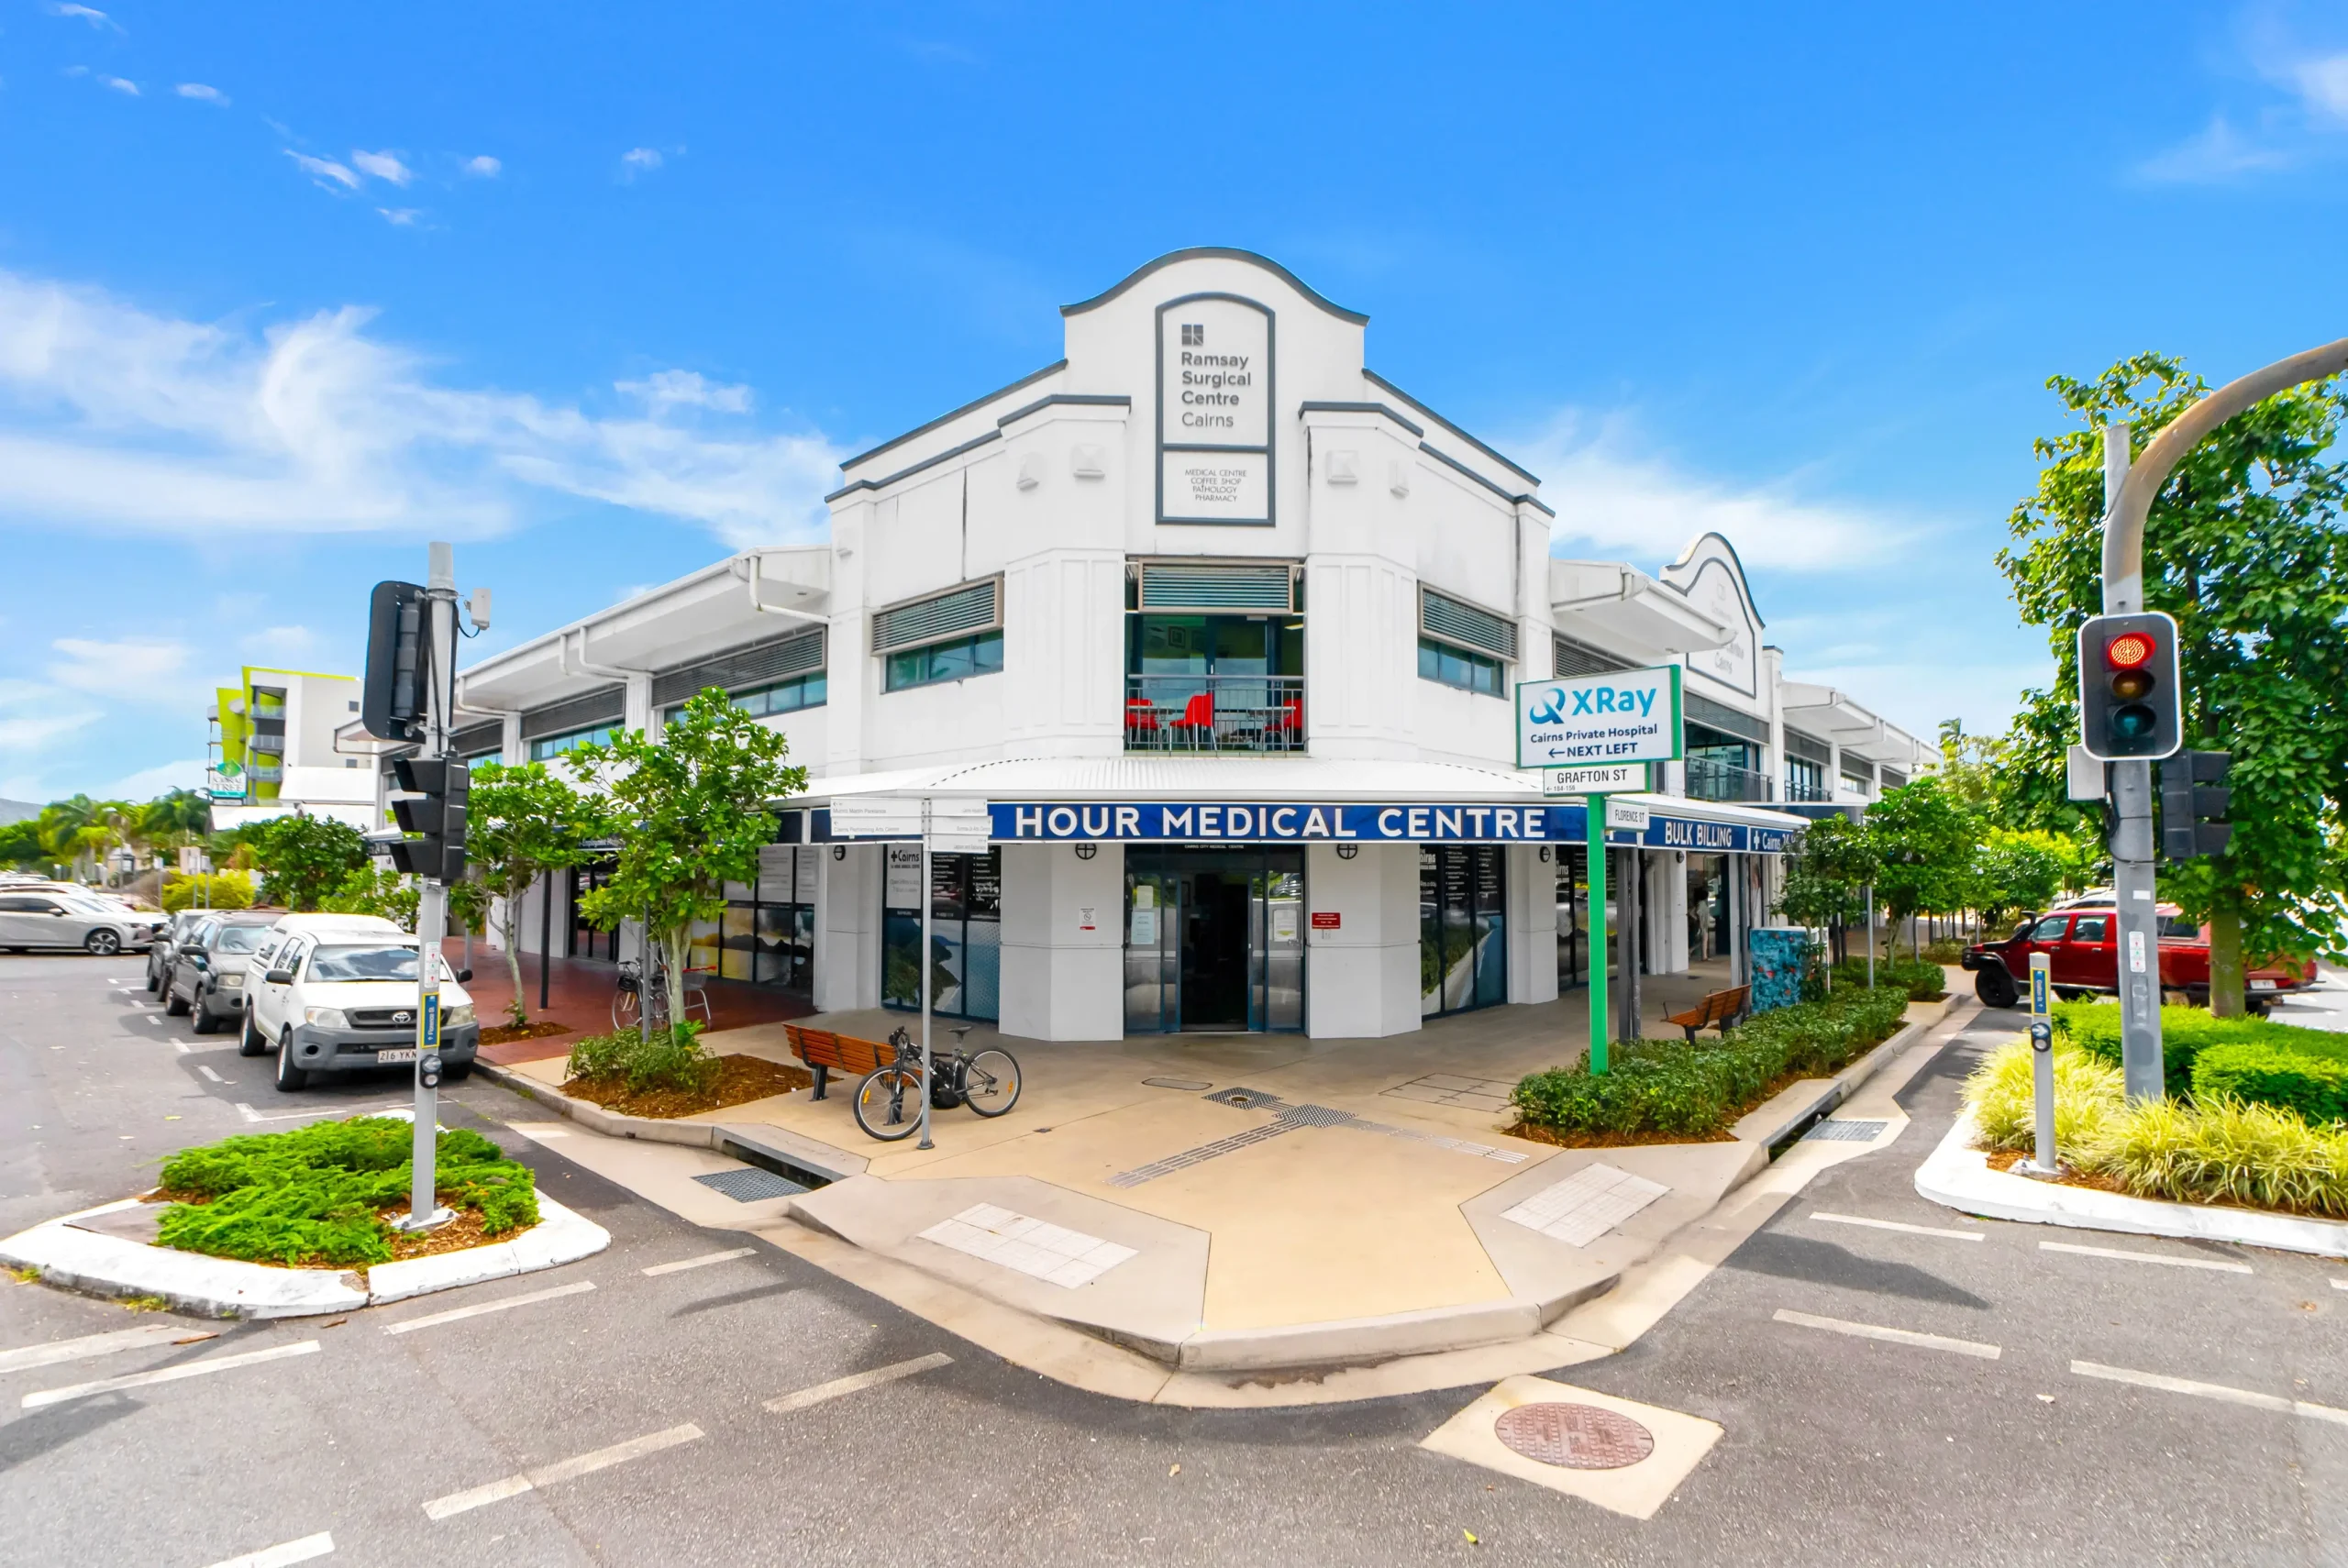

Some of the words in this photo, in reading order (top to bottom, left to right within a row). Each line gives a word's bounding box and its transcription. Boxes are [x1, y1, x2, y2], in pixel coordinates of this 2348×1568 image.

[1181, 351, 1249, 370] Ramsay
[1181, 370, 1251, 389] Surgical
[1181, 391, 1239, 405] Centre
[1181, 412, 1234, 427] Cairns
[1185, 469, 1216, 477] MEDICAL
[1220, 469, 1247, 477] CENTRE
[1191, 477, 1217, 485] COFFEE
[1221, 477, 1242, 485] SHOP
[1192, 485, 1237, 493] PATHOLOGY
[1195, 494, 1237, 502] PHARMACY
[1531, 733, 1564, 744] Cairns
[1566, 729, 1606, 742] Private
[1608, 723, 1658, 738] Hospital
[1567, 745, 1603, 757] NEXT
[1606, 743, 1639, 756] LEFT
[1557, 769, 1610, 784] GRAFTON
[1613, 768, 1628, 781] ST
[1014, 807, 1141, 837] HOUR
[1162, 807, 1357, 837] MEDICAL
[1378, 808, 1545, 838] CENTRE
[1614, 809, 1638, 823] FLORENCE
[1638, 812, 1645, 823] ST
[1665, 822, 1693, 845] BULK
[1697, 824, 1732, 847] BILLING
[1762, 832, 1781, 852] Cairns
[898, 849, 920, 862] Cairns
[380, 1051, 395, 1061] 216
